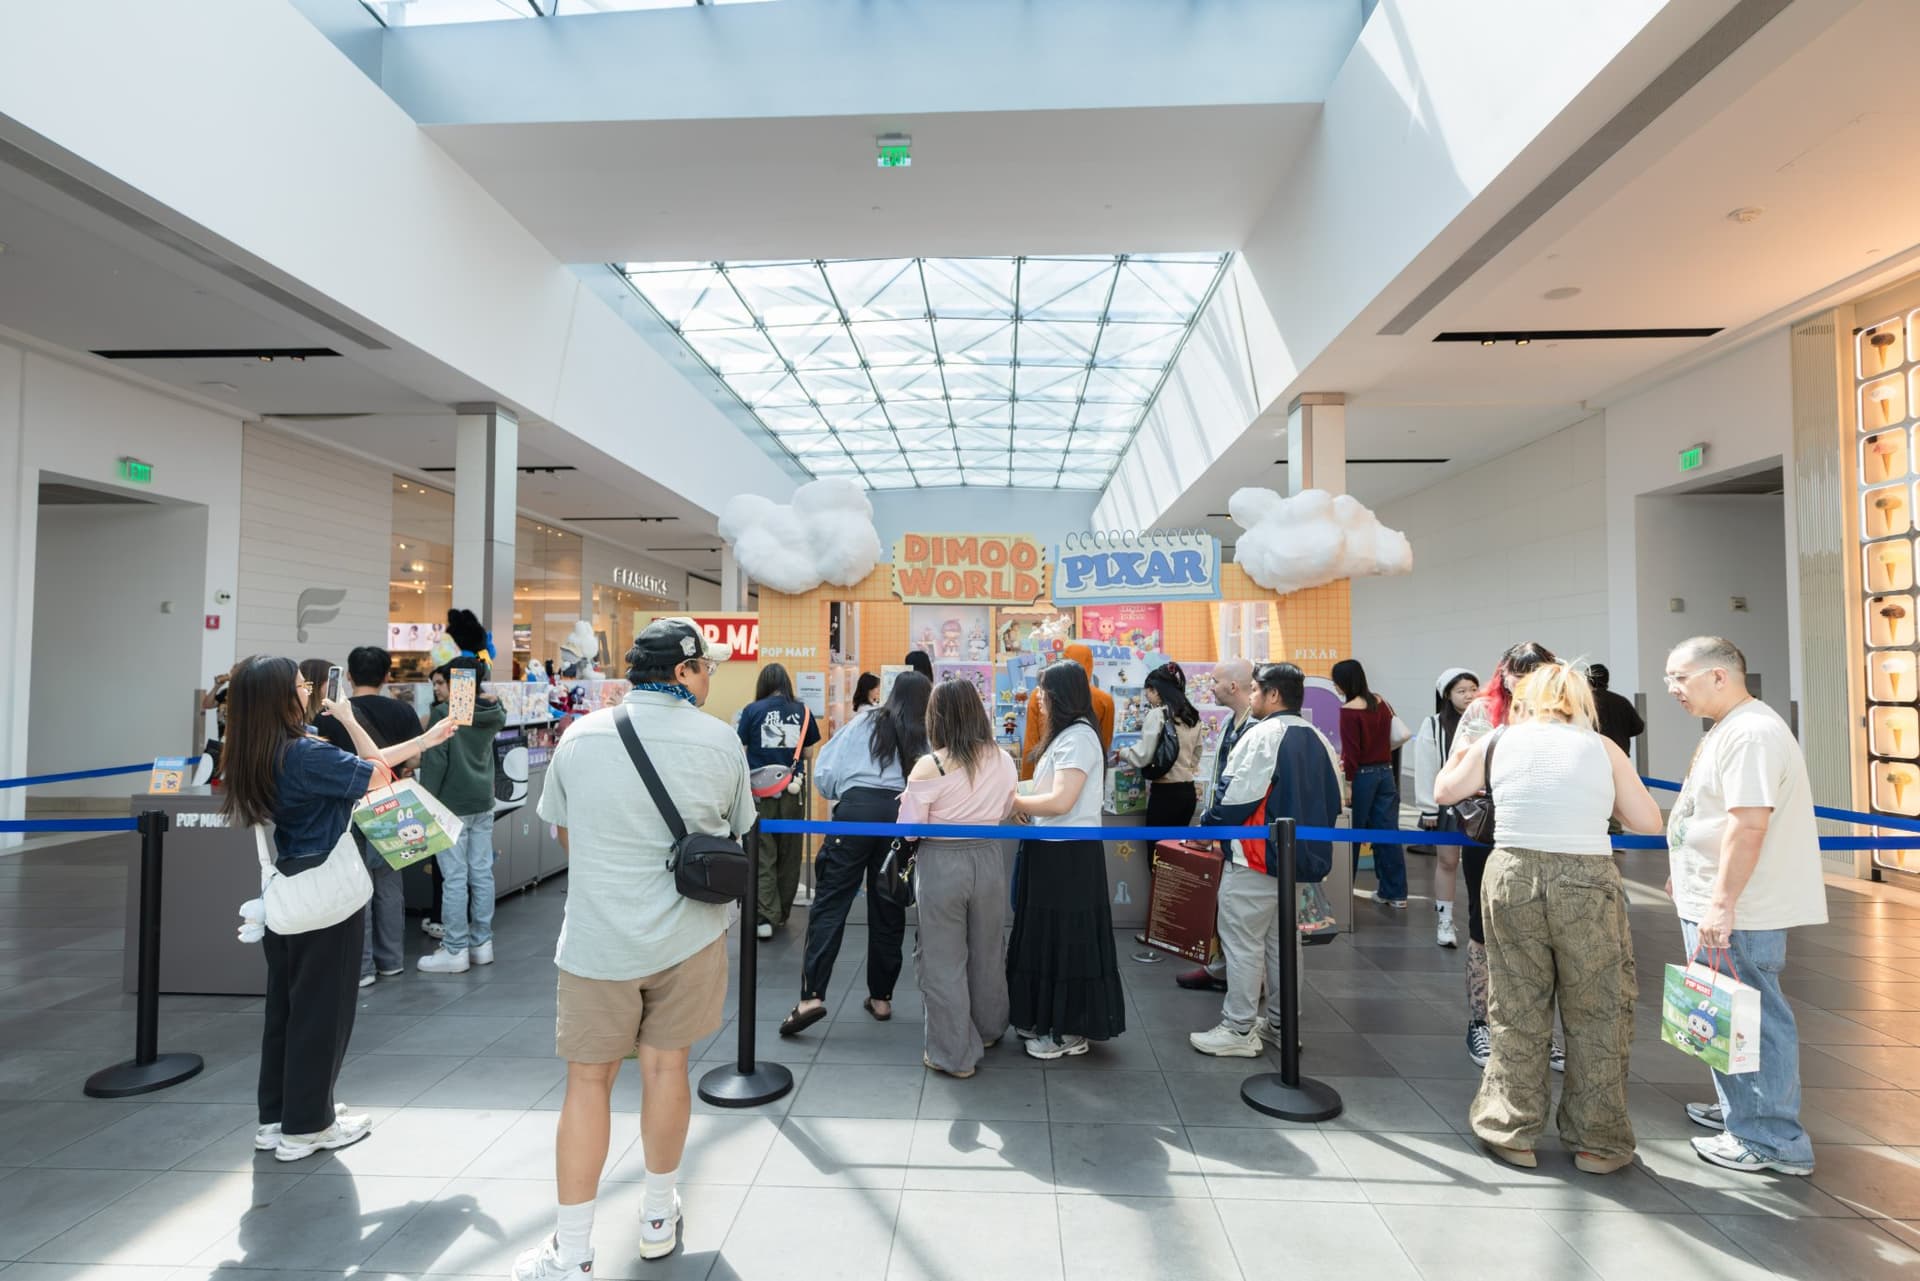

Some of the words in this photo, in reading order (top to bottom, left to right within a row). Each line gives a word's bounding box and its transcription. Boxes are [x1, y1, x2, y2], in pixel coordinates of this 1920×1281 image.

[904, 534, 1038, 571] DIMOO
[1061, 550, 1208, 589] PIXAR
[898, 567, 1039, 601] WORLD
[761, 647, 783, 657] POP
[785, 647, 817, 657] MART
[1089, 645, 1131, 659] IXAR
[1295, 648, 1338, 660] PIXAR
[176, 813, 200, 827] POP
